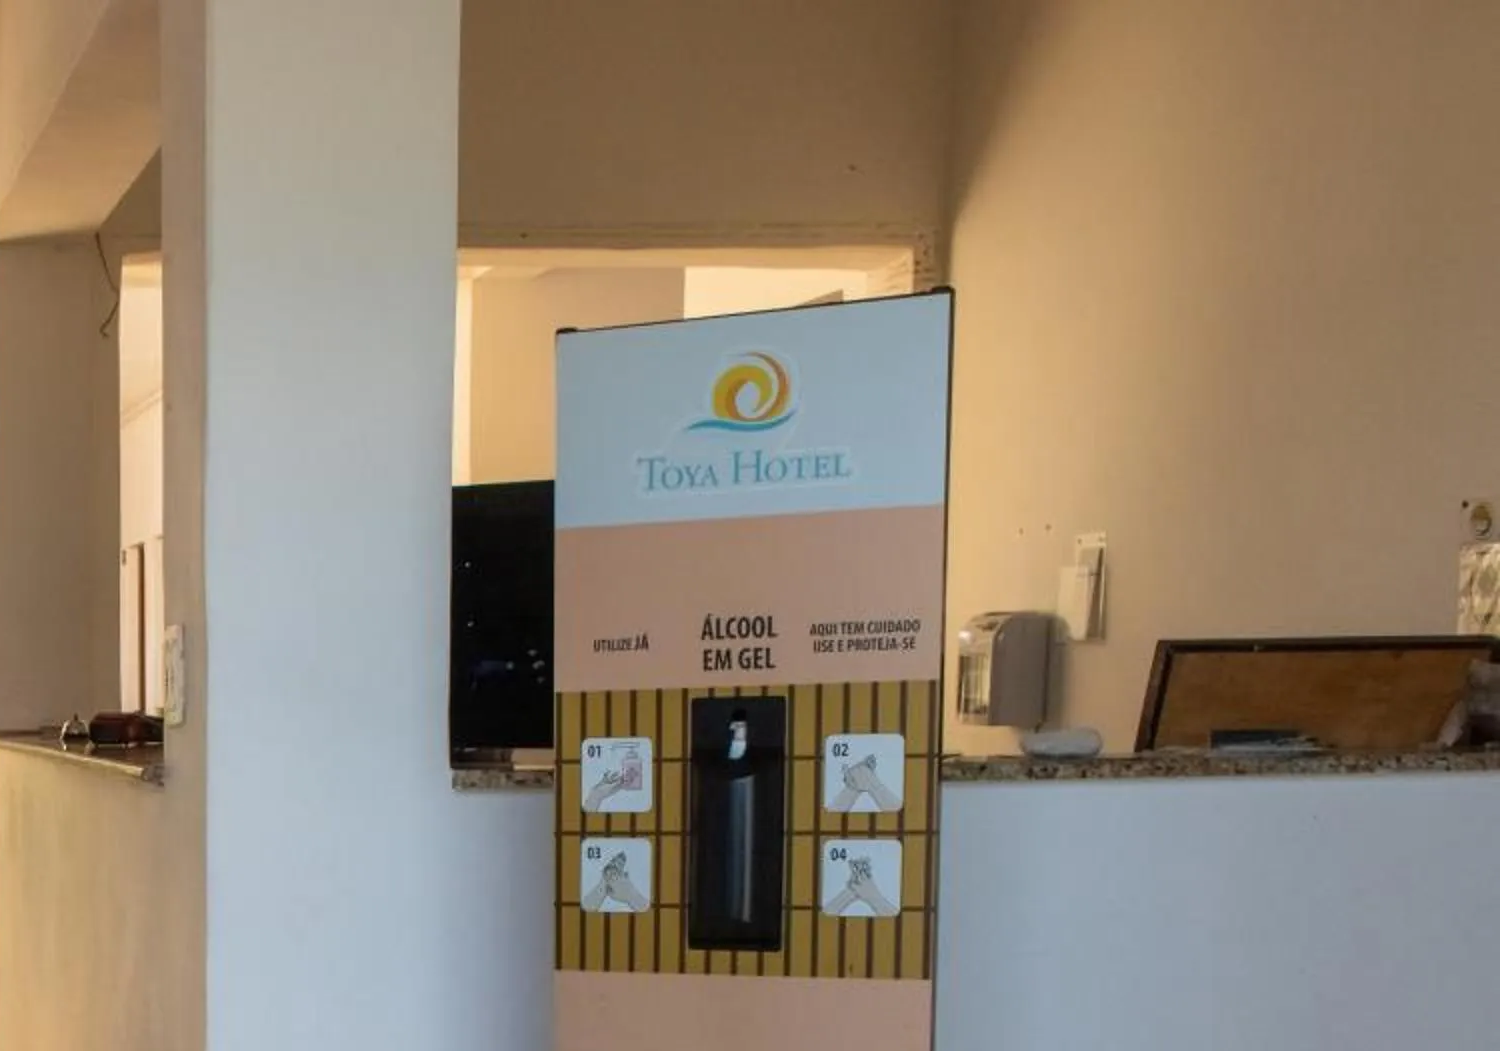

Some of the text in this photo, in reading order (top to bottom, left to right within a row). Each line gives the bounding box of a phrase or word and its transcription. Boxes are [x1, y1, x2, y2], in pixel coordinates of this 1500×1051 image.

[701, 613, 778, 641] ÁLCOOL
[810, 618, 921, 638] AQUI TEM CUIDADO
[593, 633, 649, 653] UTILIZE JÁ
[813, 639, 834, 653] USE
[837, 639, 844, 653] E
[702, 648, 776, 672] EM GEL
[587, 744, 601, 758] 01
[832, 742, 849, 758] 02
[586, 847, 601, 861] 03
[829, 847, 848, 861] 04
